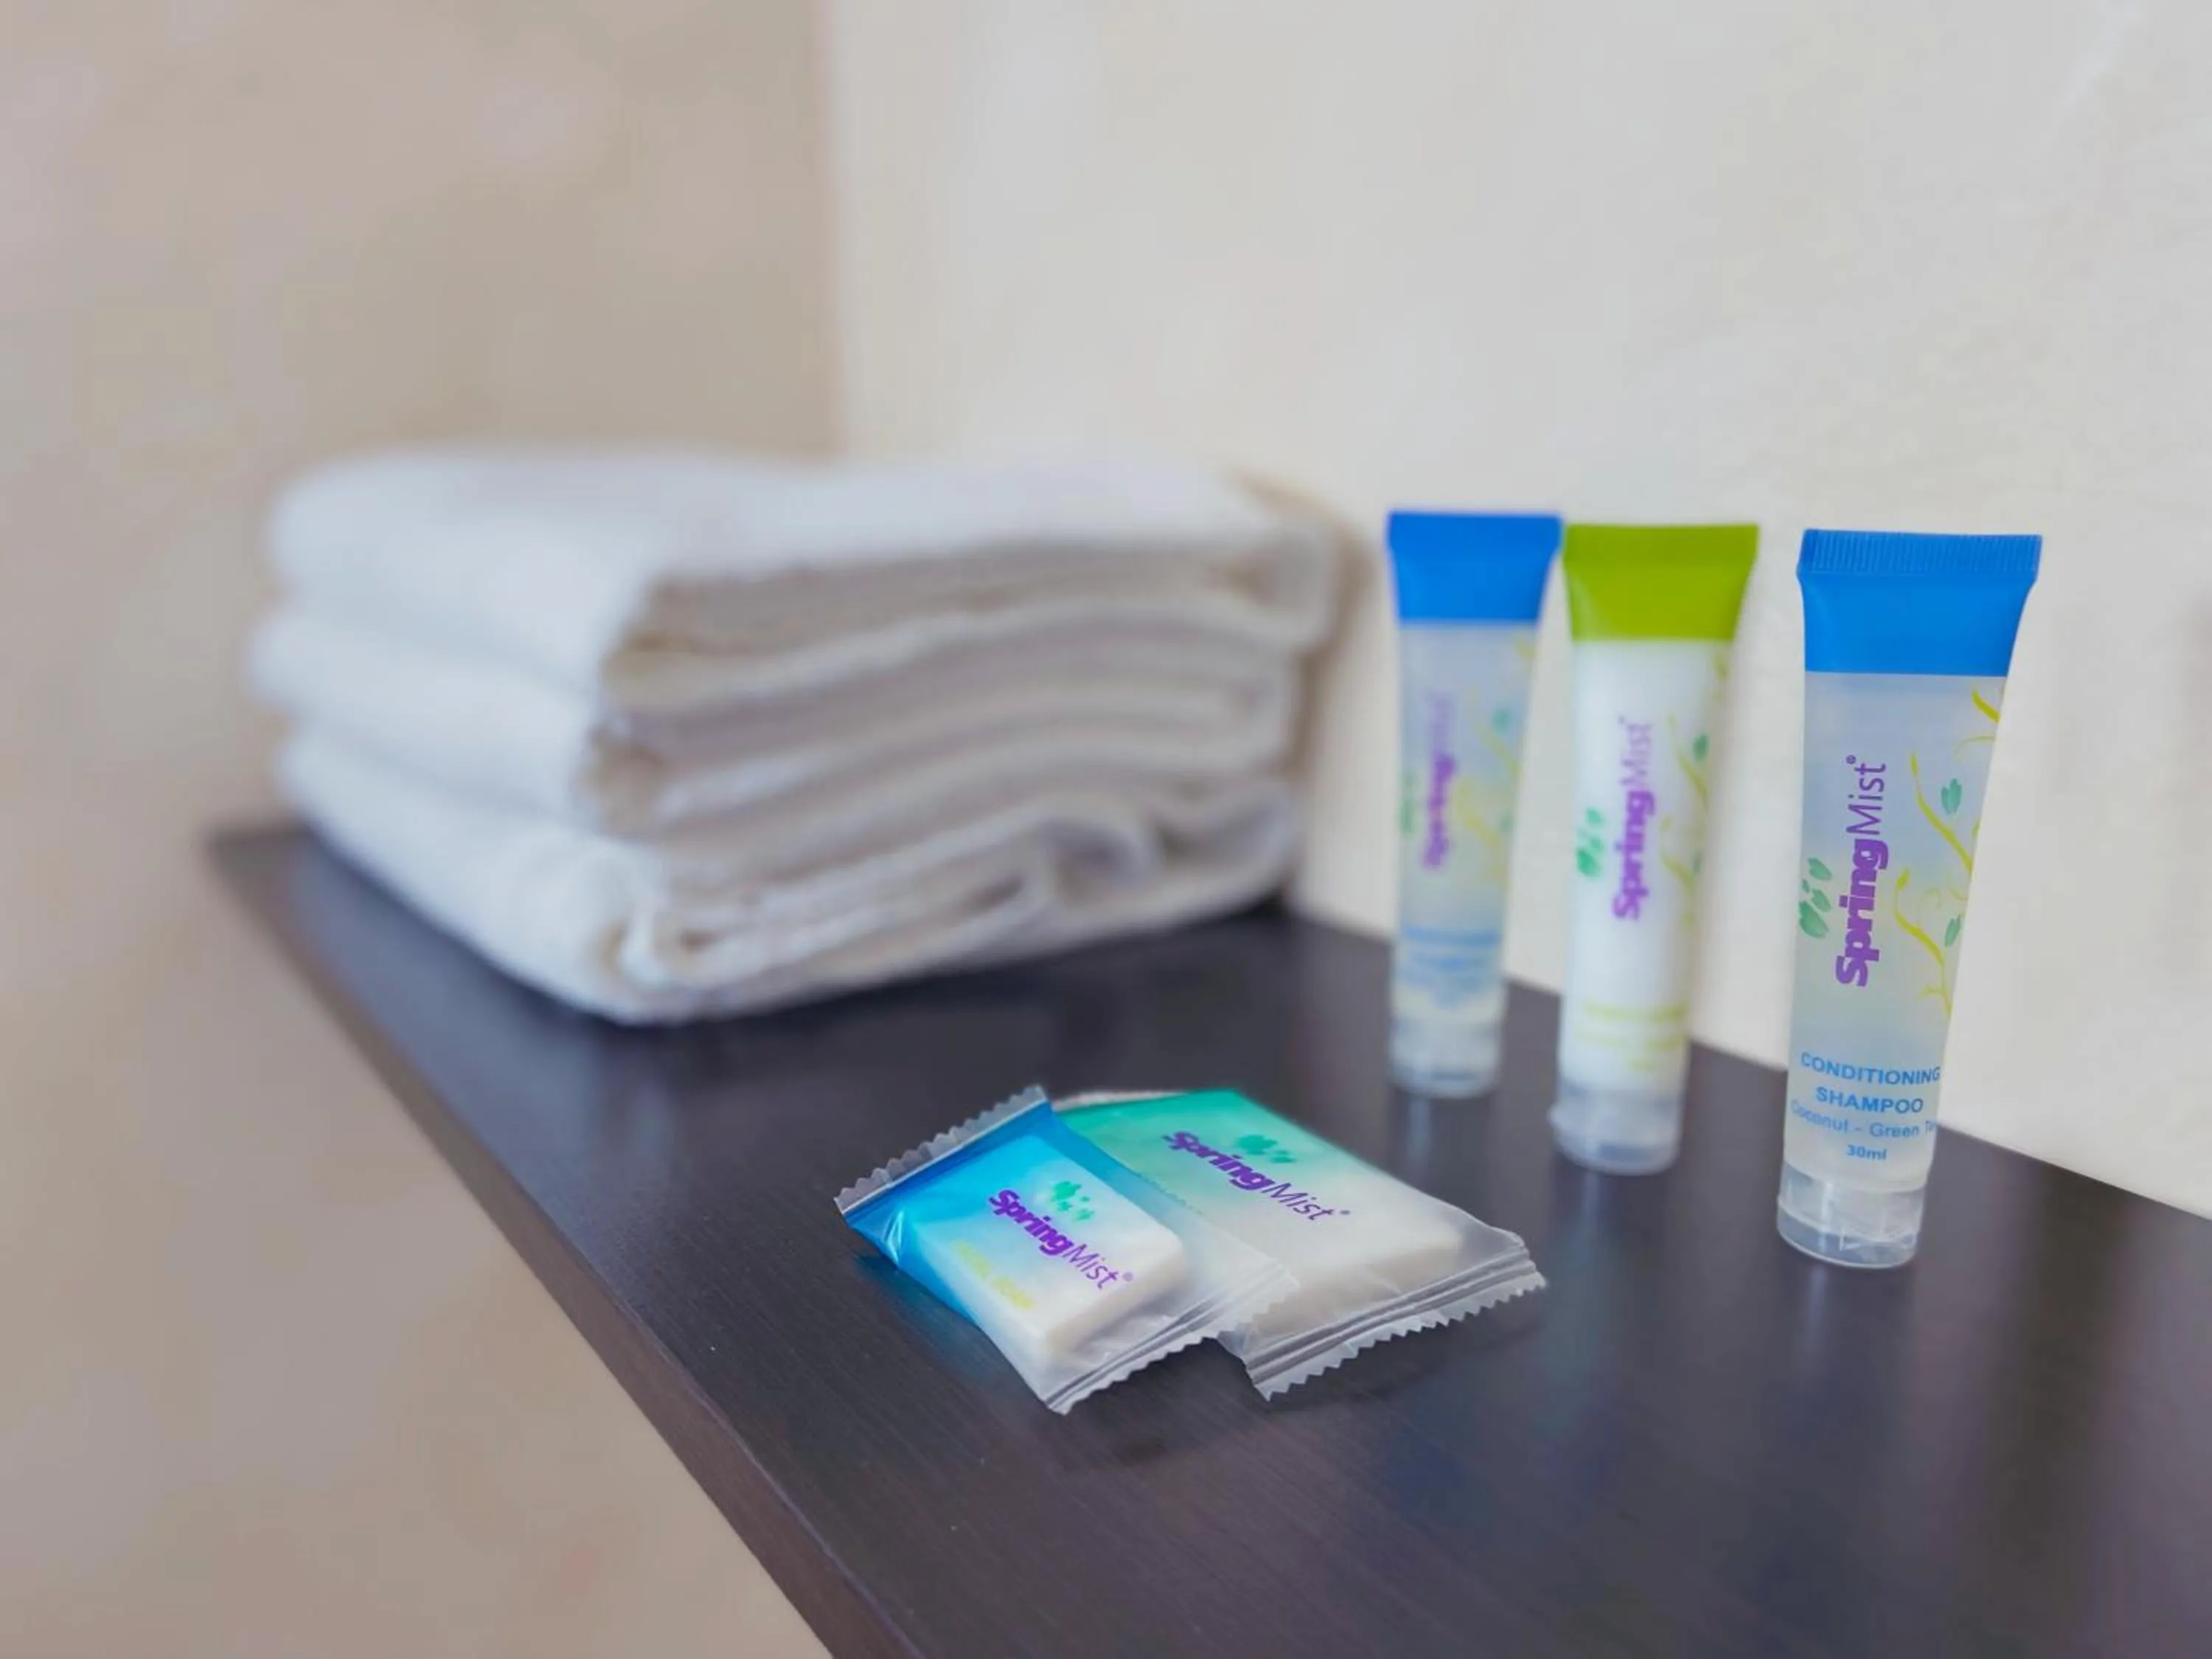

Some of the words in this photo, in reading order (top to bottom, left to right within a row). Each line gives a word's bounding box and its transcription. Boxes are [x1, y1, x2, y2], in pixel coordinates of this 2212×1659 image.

[1801, 1052, 1941, 1085] CONDITIONING
[1815, 1087, 1924, 1113] SHAMPOO
[1869, 1122, 1919, 1138] Green
[1846, 1144, 1888, 1161] 30ml
